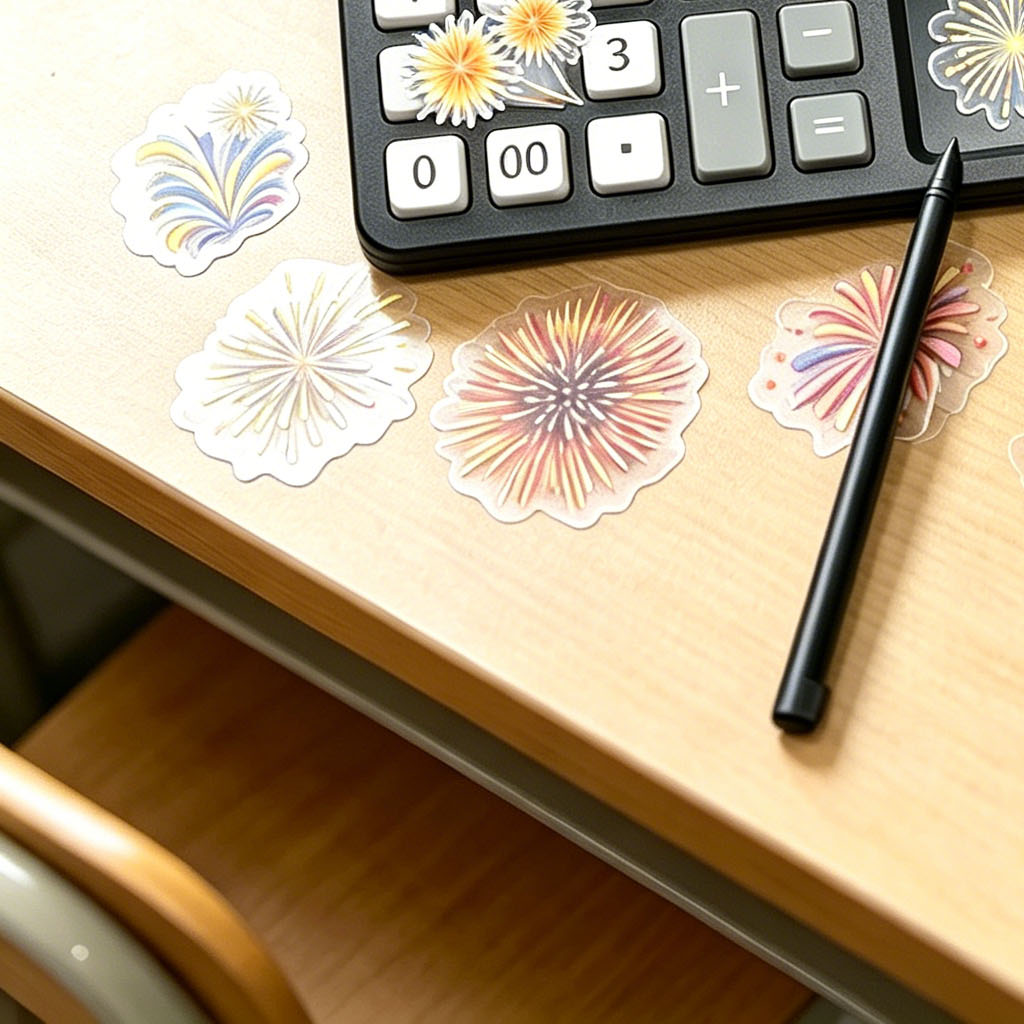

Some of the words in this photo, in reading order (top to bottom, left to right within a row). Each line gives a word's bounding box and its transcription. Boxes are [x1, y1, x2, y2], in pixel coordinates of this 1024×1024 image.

[606, 37, 631, 73] 3
[412, 154, 437, 191] 0
[499, 141, 550, 180] 00
